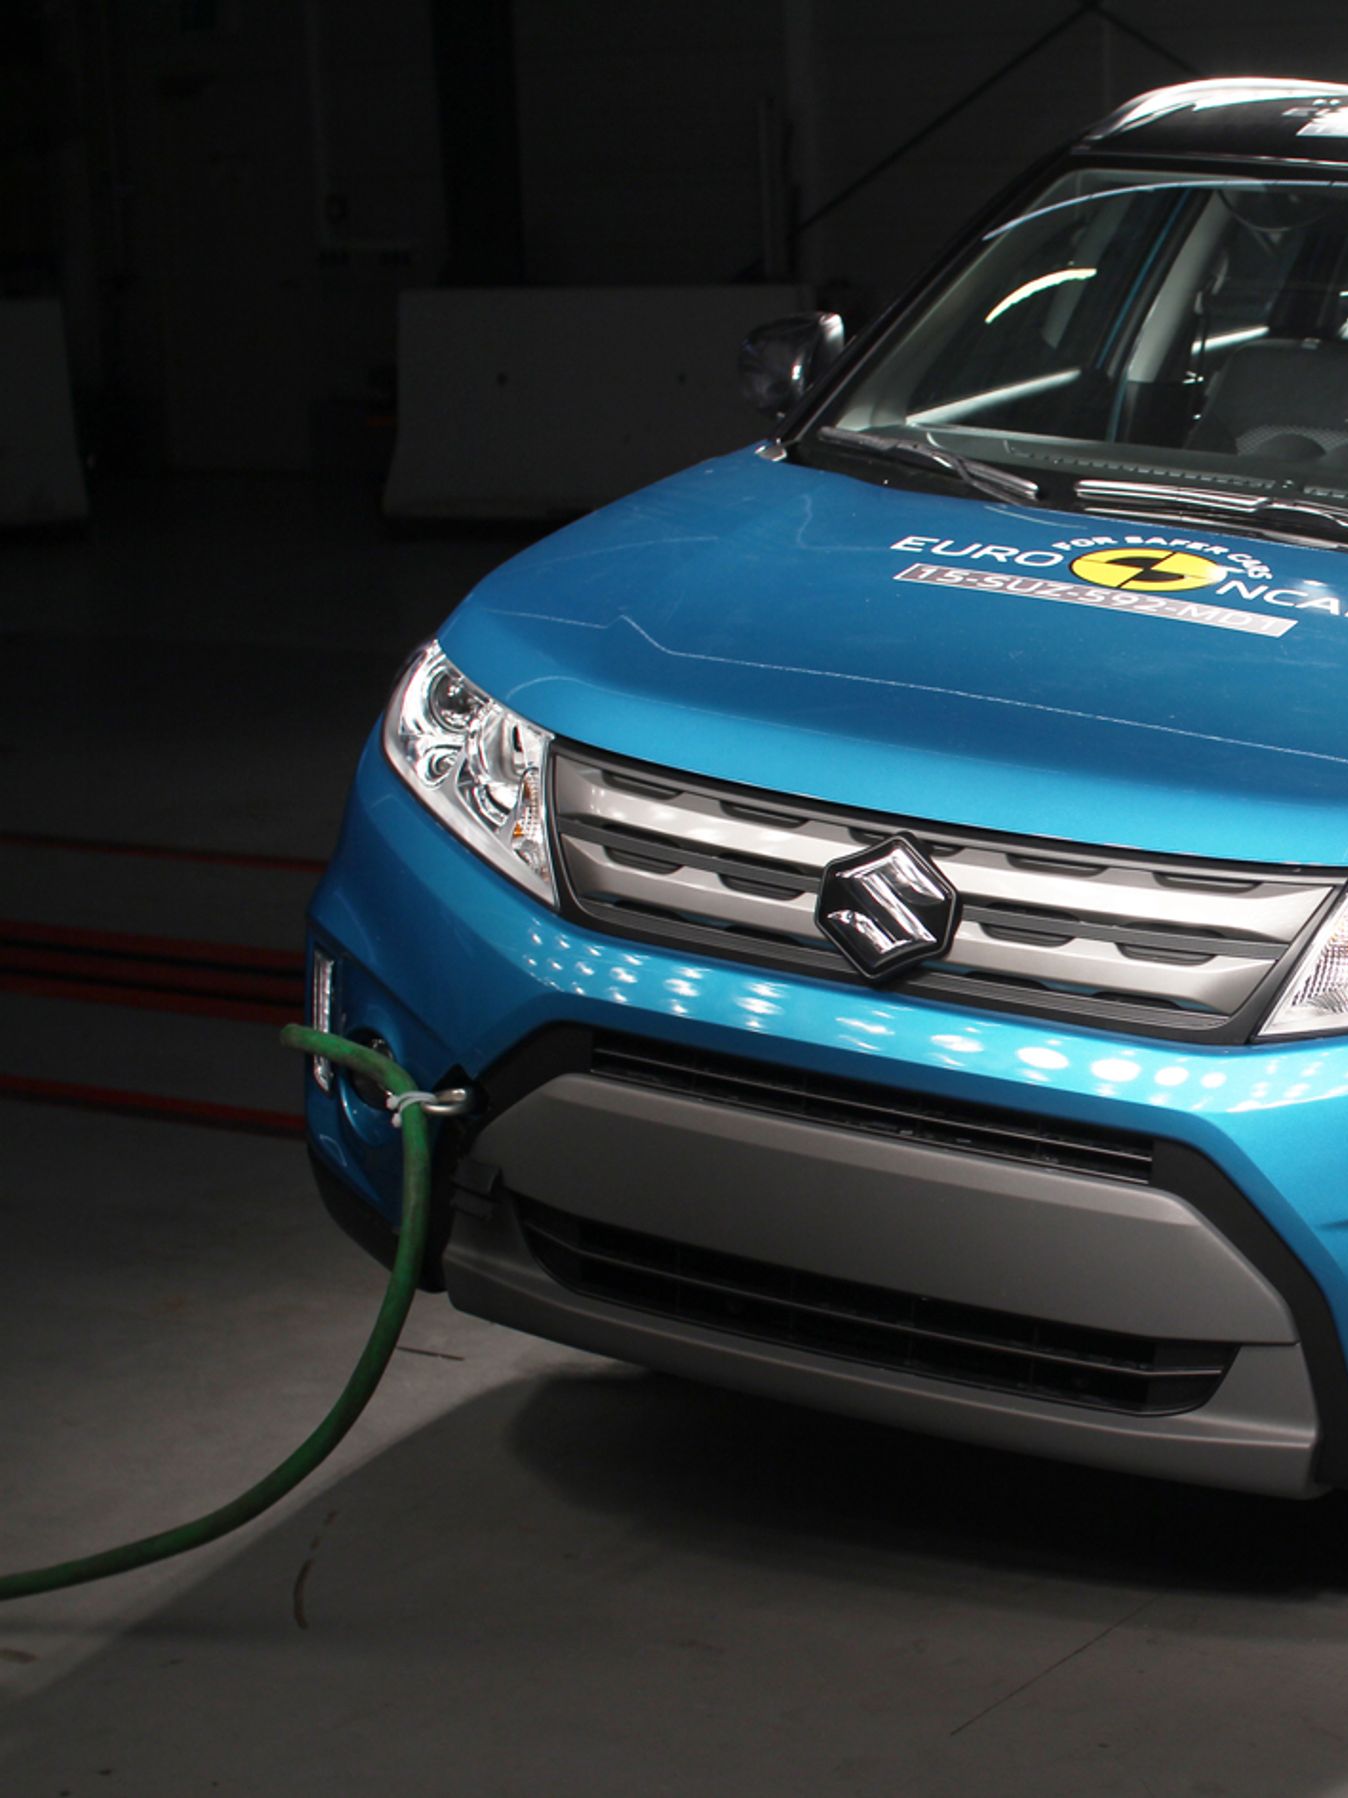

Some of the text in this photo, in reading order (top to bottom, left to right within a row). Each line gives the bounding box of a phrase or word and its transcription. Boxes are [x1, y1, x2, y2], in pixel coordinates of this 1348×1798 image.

[889, 535, 1064, 567] EURO
[1052, 536, 1118, 551] FOR
[1124, 536, 1229, 555] SAFER
